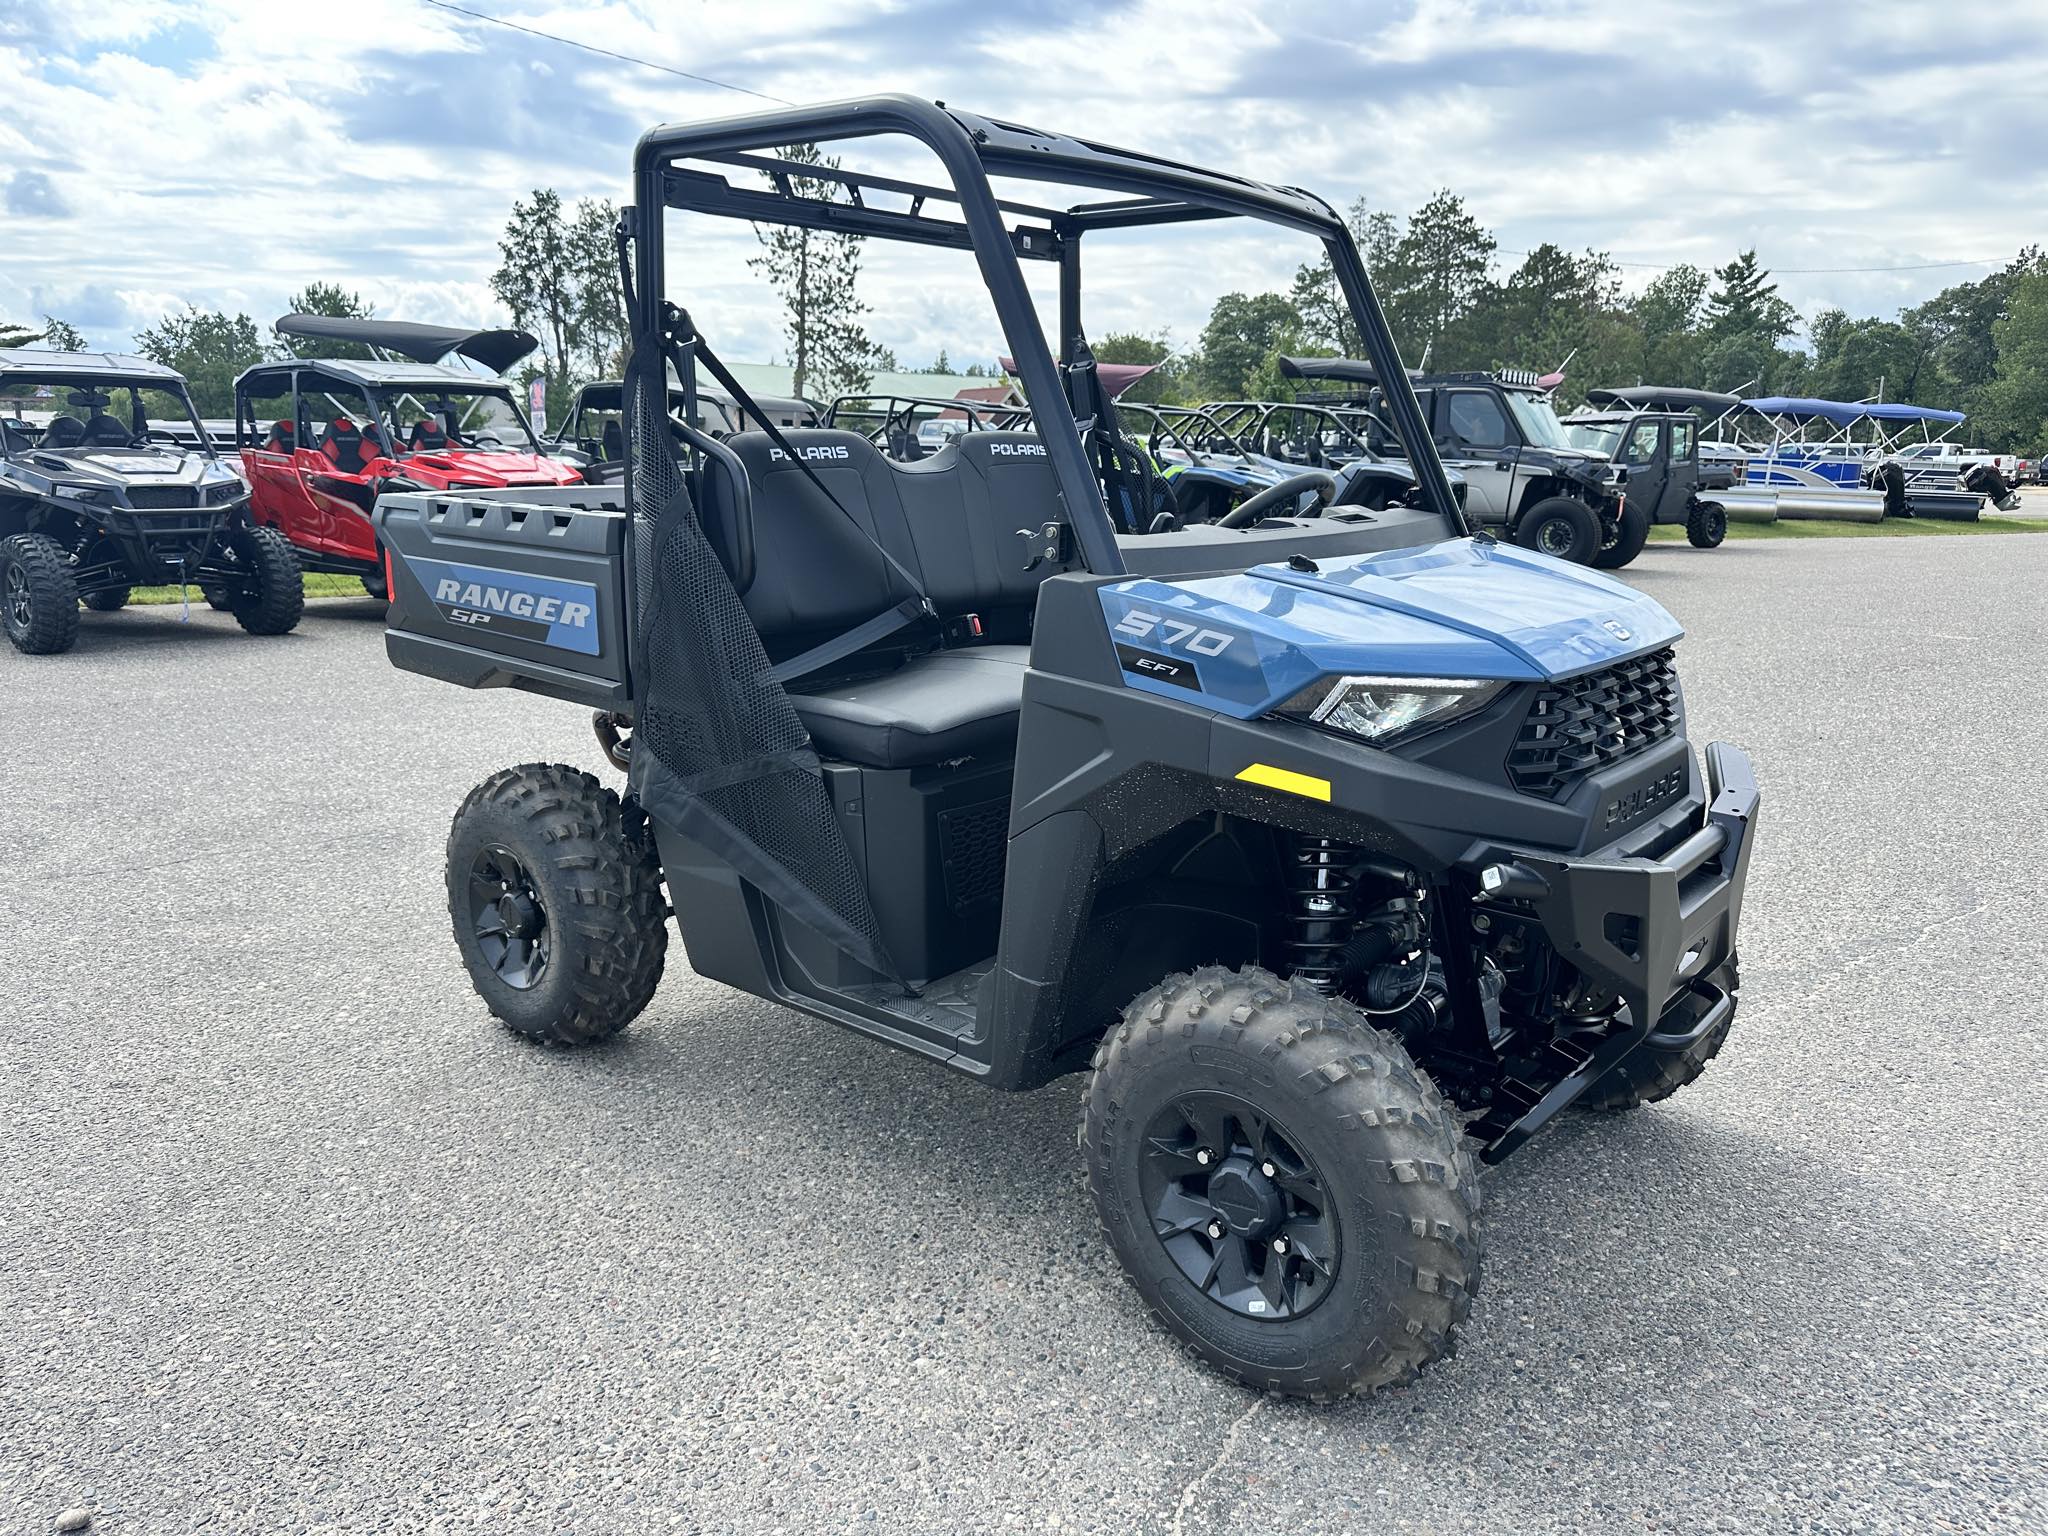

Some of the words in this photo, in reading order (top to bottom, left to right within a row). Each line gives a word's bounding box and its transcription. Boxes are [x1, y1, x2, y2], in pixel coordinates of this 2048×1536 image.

[990, 443, 1047, 456] POLARIS
[436, 578, 591, 628] RANGER
[449, 608, 491, 624] SP
[1114, 609, 1235, 657] 570
[1136, 658, 1180, 676] EFI
[1604, 767, 1682, 832] POLARIS
